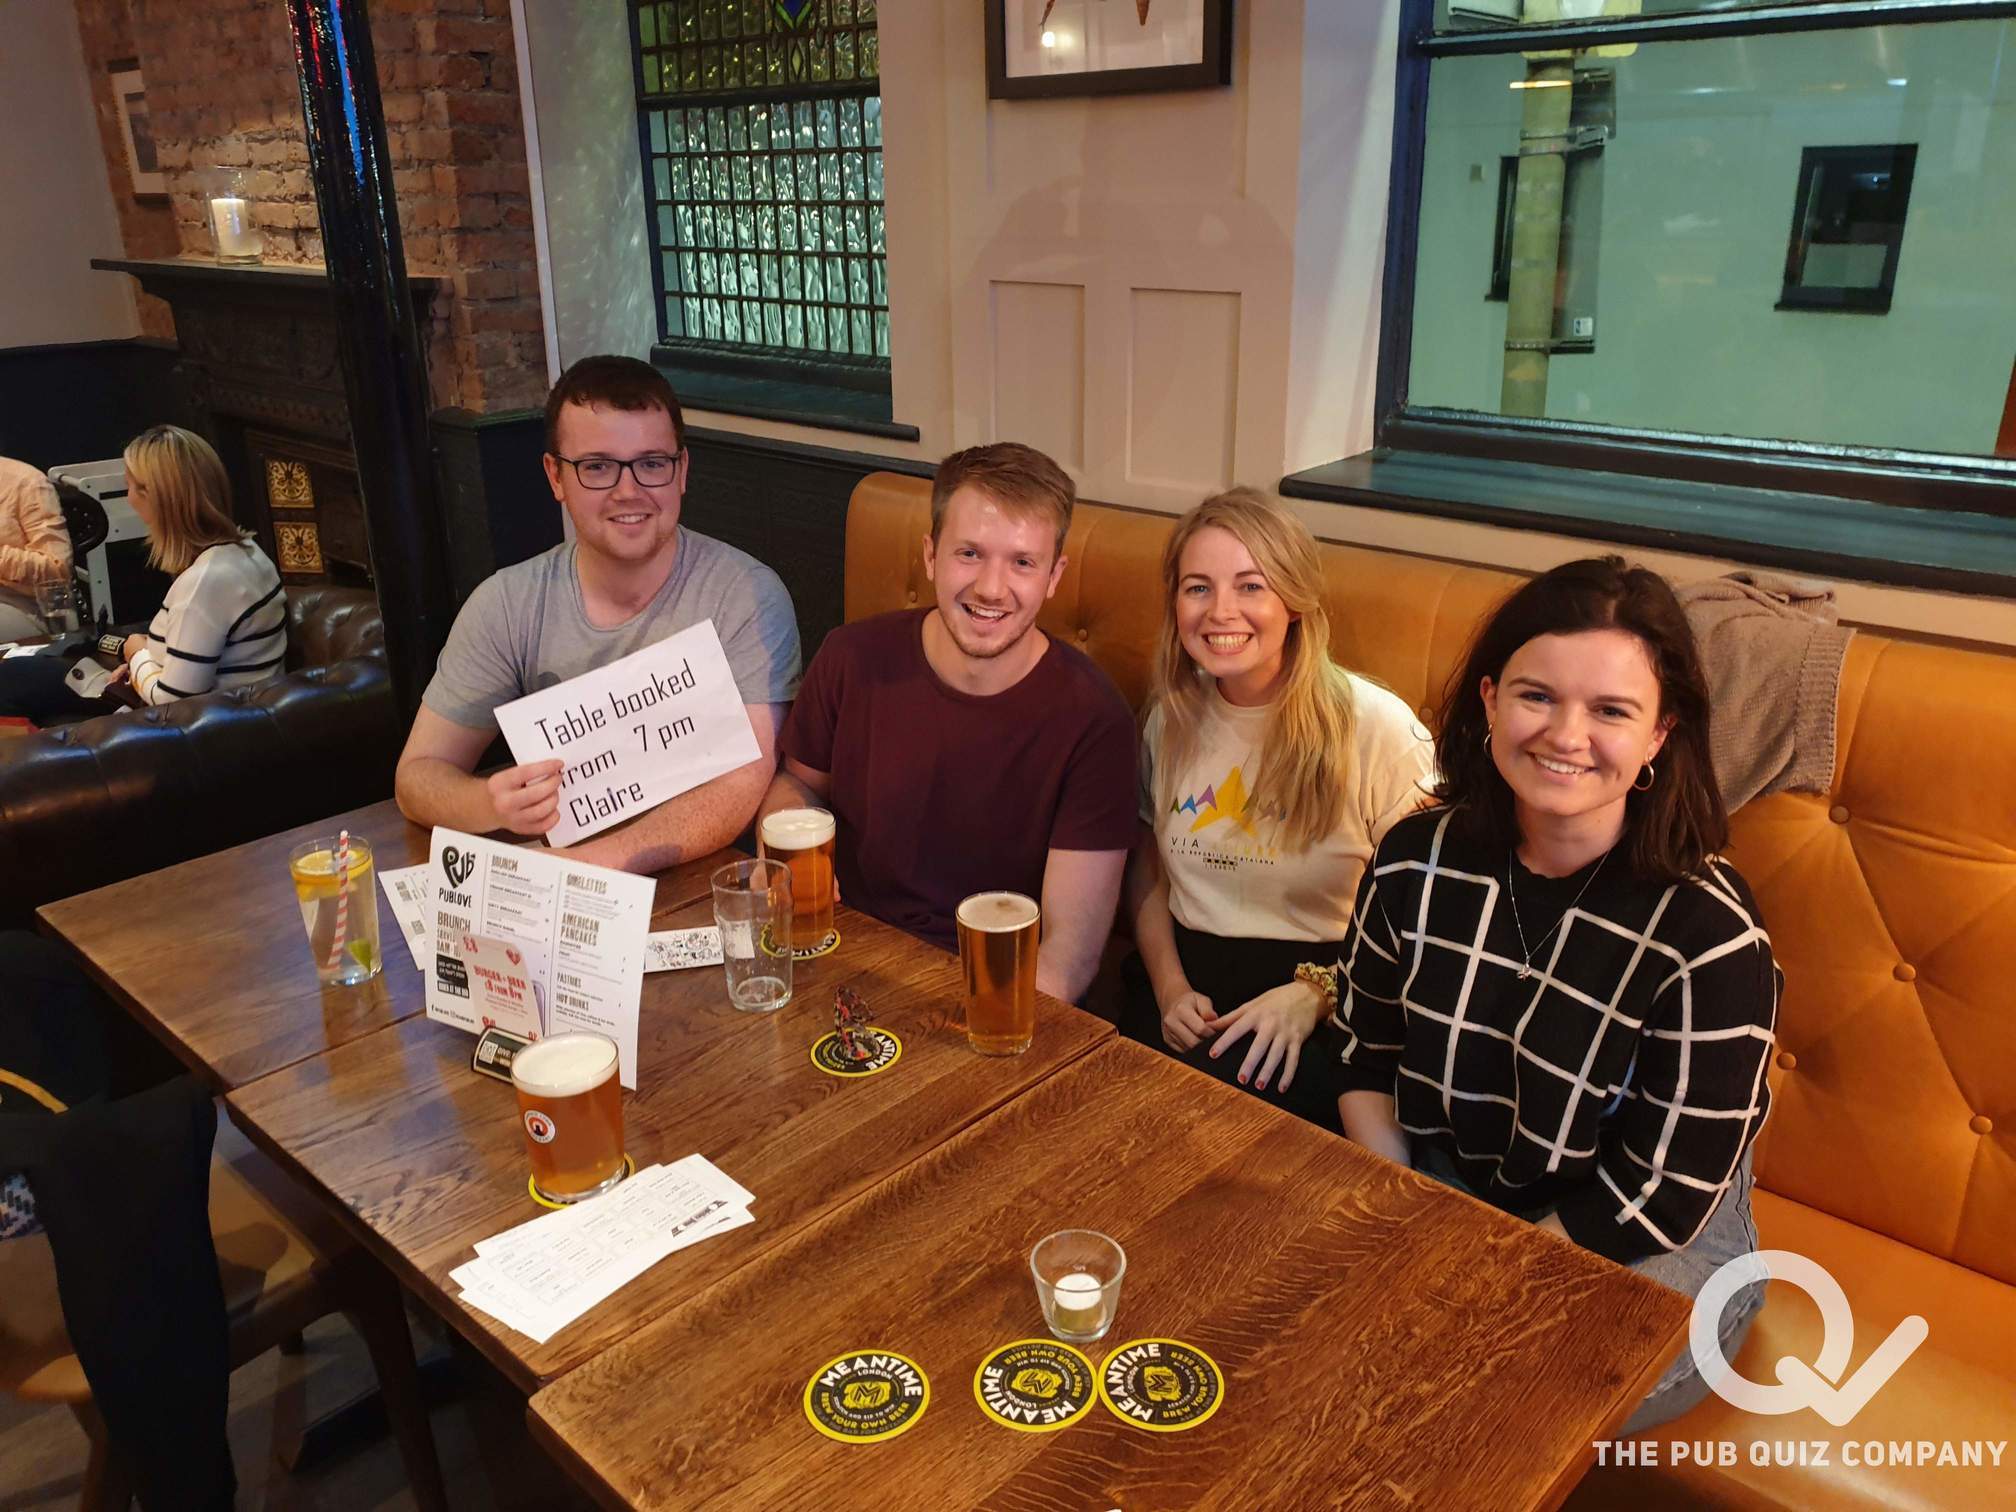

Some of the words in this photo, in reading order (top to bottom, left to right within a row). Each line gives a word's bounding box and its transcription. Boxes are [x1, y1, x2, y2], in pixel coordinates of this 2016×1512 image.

[534, 704, 607, 750] Table
[609, 658, 696, 719] booked
[633, 724, 648, 752] 7
[658, 716, 695, 750] pm
[569, 782, 644, 828] Claire
[1171, 836, 1199, 848] VIA
[438, 887, 472, 908] PUBLOVE
[437, 910, 471, 933] BRUNCH
[819, 1355, 922, 1397] MEANTIME
[857, 1368, 893, 1380] LONDON
[1107, 1343, 1160, 1421] MEANTIME
[983, 1365, 1077, 1424] MEANTIME
[860, 1417, 887, 1430] OWN
